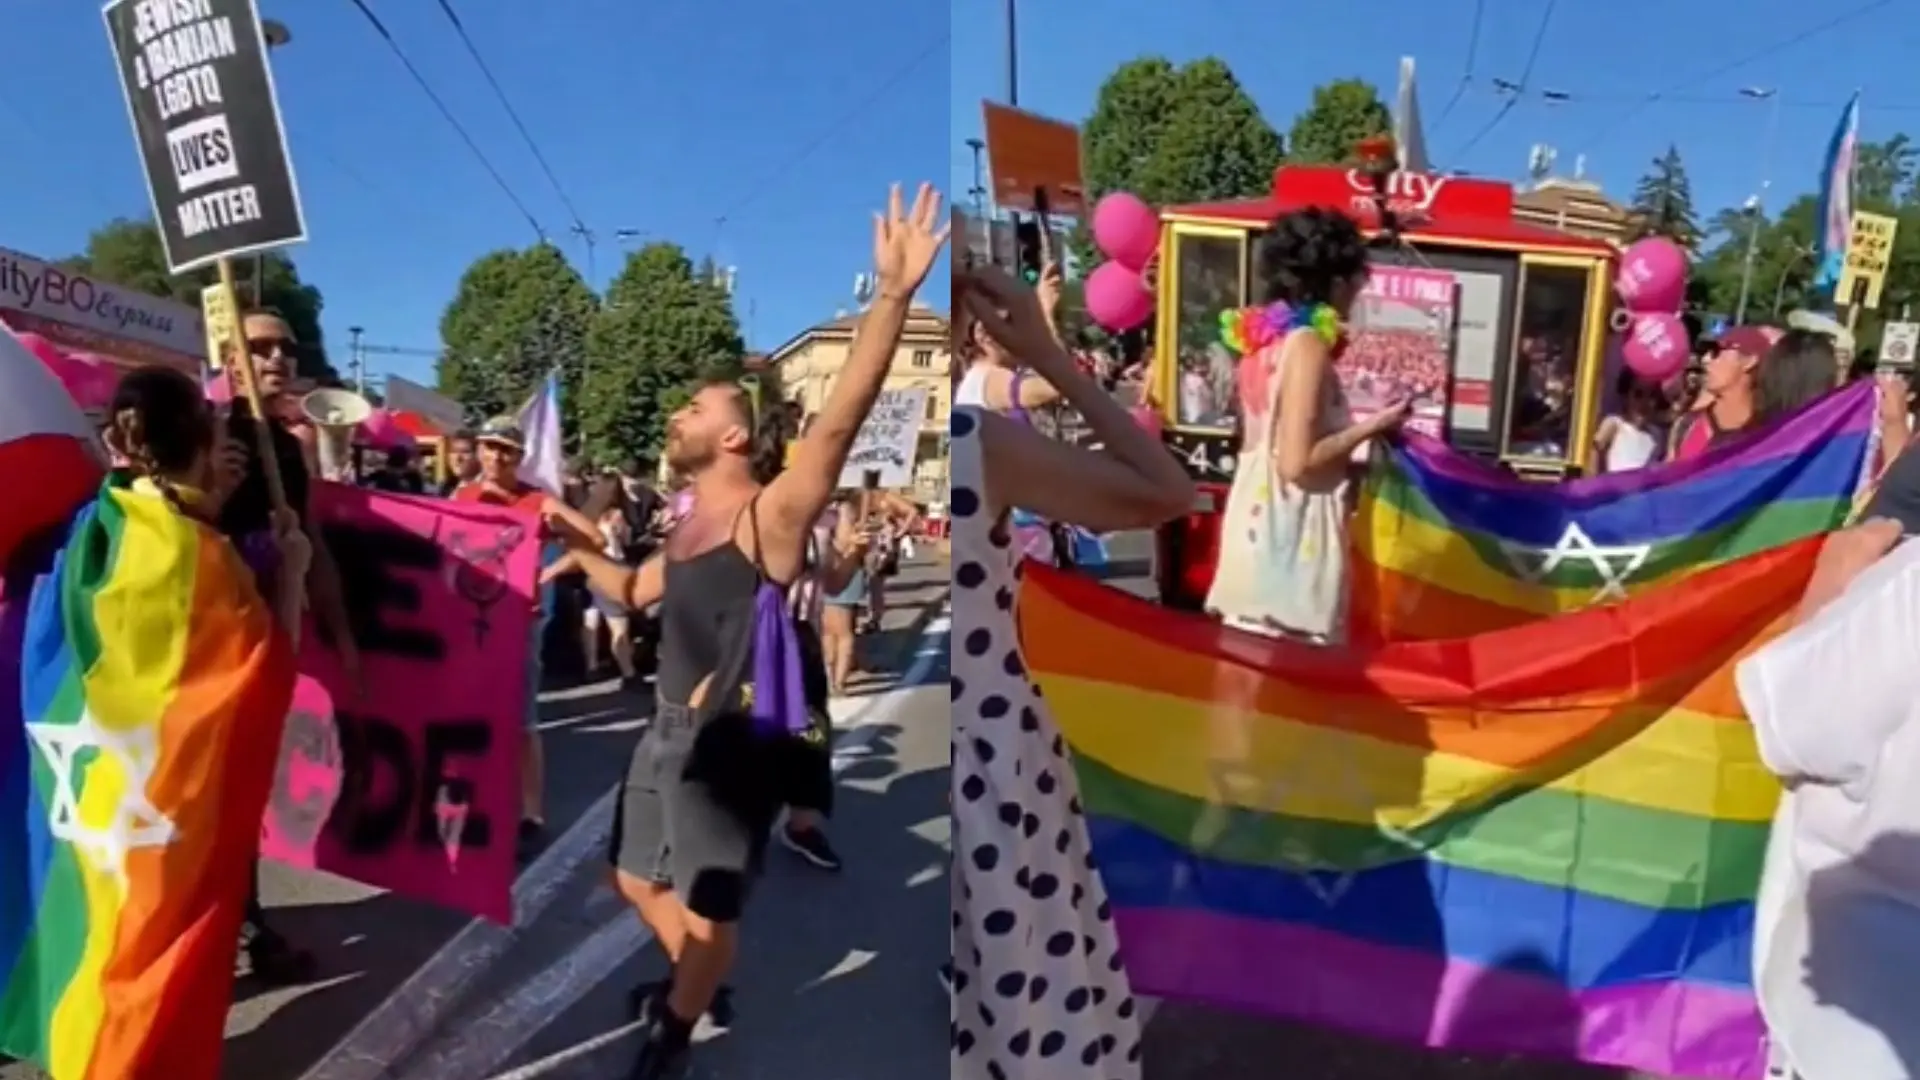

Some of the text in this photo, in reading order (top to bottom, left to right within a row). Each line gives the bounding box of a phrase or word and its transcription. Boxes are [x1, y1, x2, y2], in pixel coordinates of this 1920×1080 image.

[145, 17, 236, 81] IRANIAN
[154, 65, 223, 119] LGBTQ
[171, 128, 230, 177] LIVES
[177, 186, 261, 238] MATTER
[0, 257, 95, 313] ityBO
[95, 292, 174, 333] Express
[1187, 442, 1211, 474] 4
